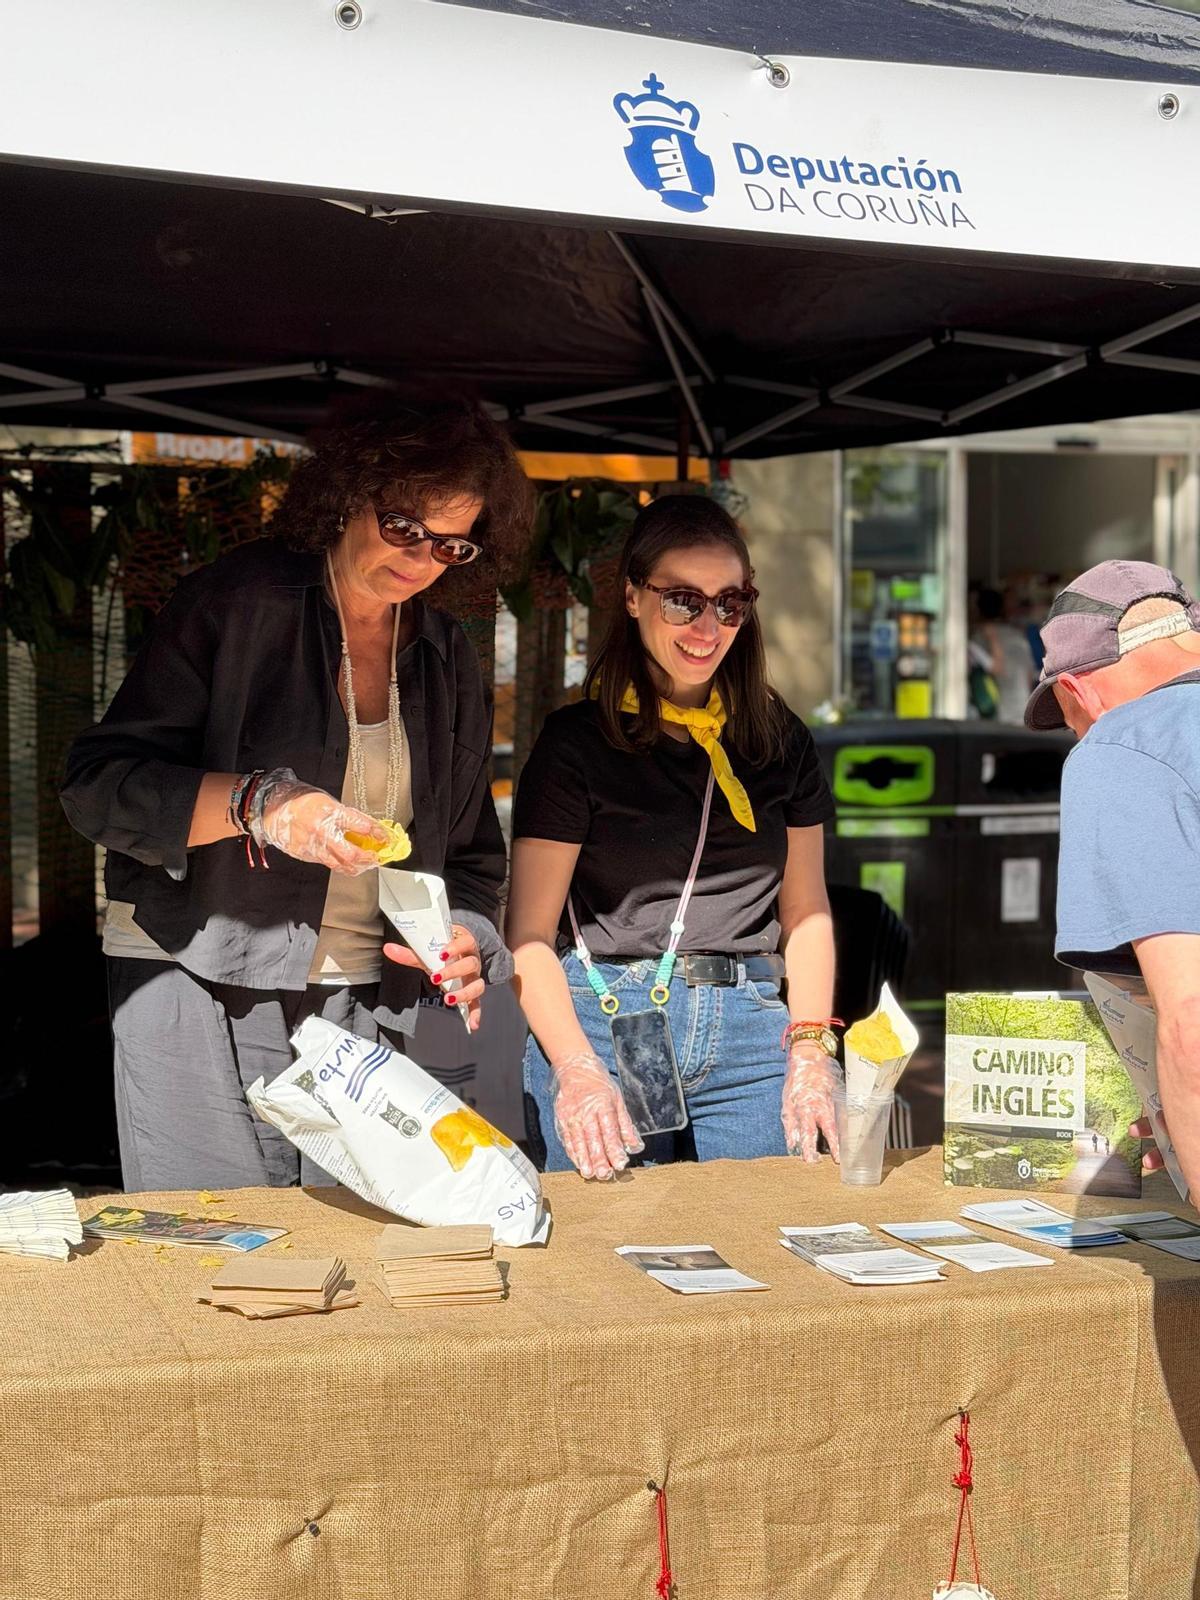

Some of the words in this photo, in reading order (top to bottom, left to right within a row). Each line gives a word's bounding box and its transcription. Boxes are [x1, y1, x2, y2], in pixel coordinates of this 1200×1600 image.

[732, 142, 962, 194] Deputación
[744, 183, 804, 215] DA
[812, 190, 976, 230] CORUÑA
[972, 1048, 1075, 1077] CAMINO
[972, 1079, 1075, 1119] INGLÉS
[498, 1186, 541, 1220] TAS
